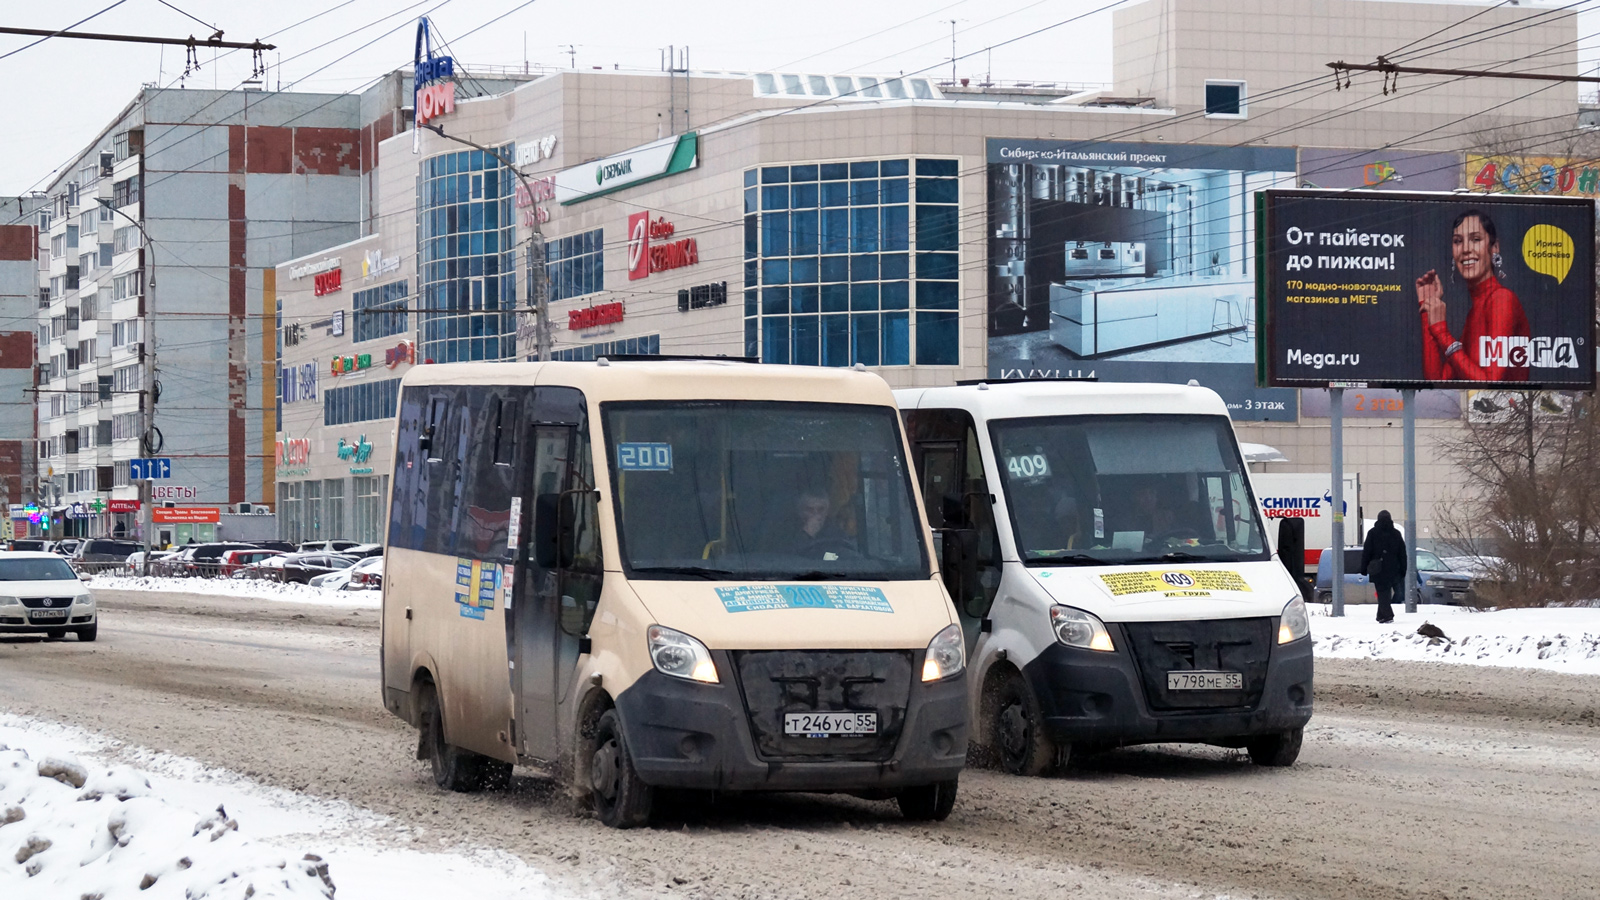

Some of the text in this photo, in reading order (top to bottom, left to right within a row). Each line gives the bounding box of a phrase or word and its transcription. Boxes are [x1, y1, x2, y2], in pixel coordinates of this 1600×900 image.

[1000, 147, 1167, 164] Сибирско-Итальянский проект
[603, 158, 633, 181] СБЕРБАНК
[1286, 226, 1405, 247] От пайеток
[1536, 239, 1563, 248] Ирина
[1286, 252, 1396, 271] до пижам!
[1286, 280, 1402, 292] 170 модно-новогодних
[1286, 295, 1378, 305] магазинов в МЕГЕ
[1286, 348, 1360, 369] Mega.ru
[1244, 399, 1252, 410] 3
[1254, 401, 1285, 410] этаж
[1355, 393, 1366, 411] 2
[620, 446, 669, 467] 200
[1007, 454, 1048, 477] 409
[1164, 573, 1191, 585] 409
[785, 586, 826, 607] 200
[1173, 674, 1238, 688] У798МЕ 55
[791, 715, 872, 731] Т246УС 55
